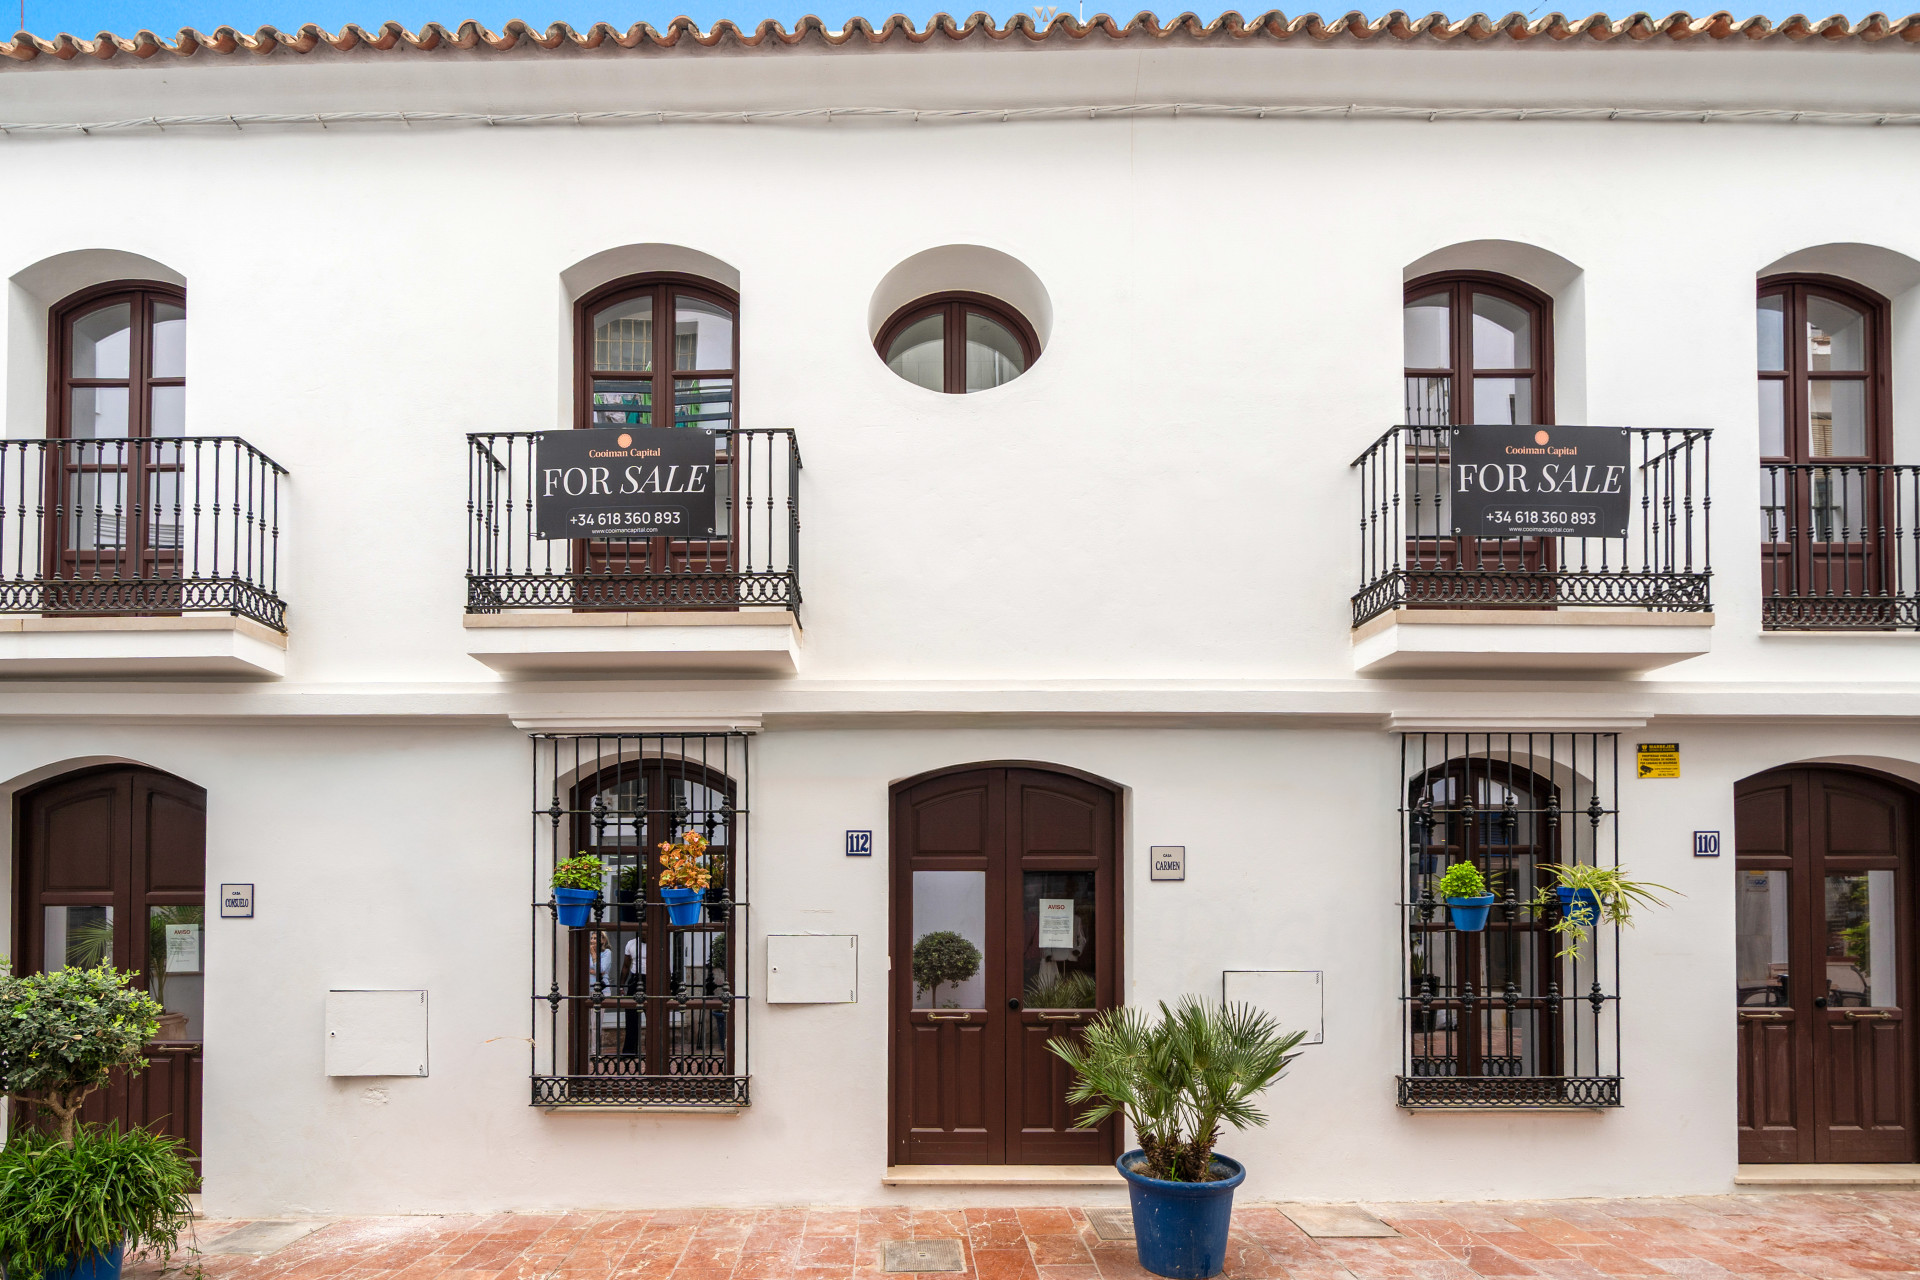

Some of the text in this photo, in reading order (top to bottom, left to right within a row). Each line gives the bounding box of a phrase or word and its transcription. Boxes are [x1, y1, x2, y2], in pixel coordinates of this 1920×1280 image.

[589, 448, 661, 459] Cooiman Capital
[1505, 446, 1577, 457] Cooiman Capital
[543, 465, 710, 497] FOR SALE
[1457, 463, 1625, 494] FOR SALE
[570, 511, 681, 526] +34 618 360 893
[1486, 511, 1596, 525] +34 618 360 893
[849, 834, 868, 852] 112
[1698, 835, 1717, 853] 110
[1155, 861, 1180, 870] CARMEN
[225, 898, 249, 907] CONSUELO
